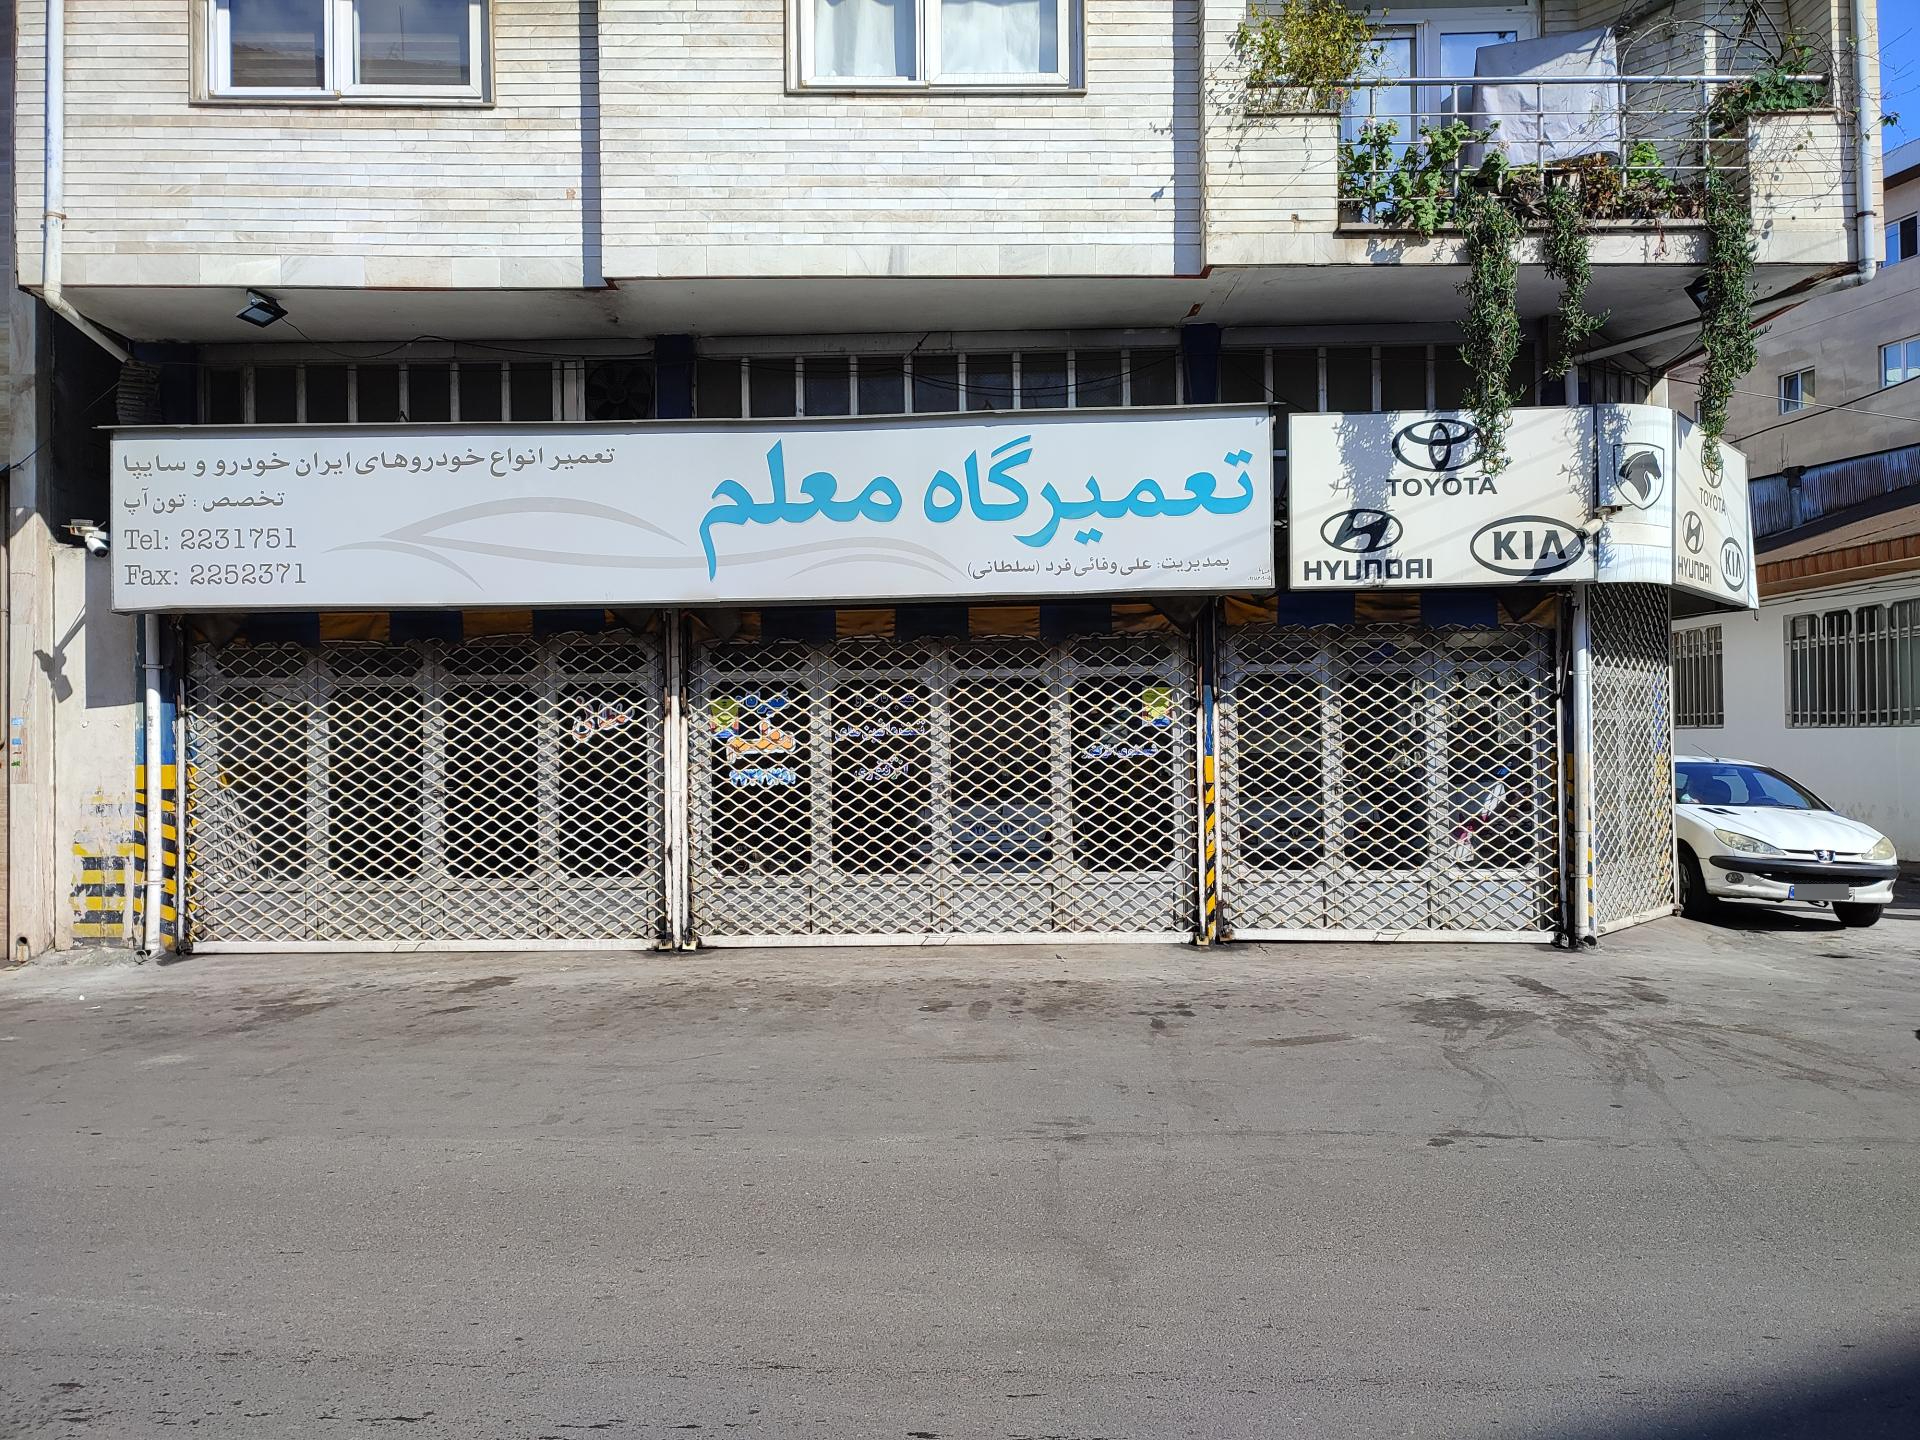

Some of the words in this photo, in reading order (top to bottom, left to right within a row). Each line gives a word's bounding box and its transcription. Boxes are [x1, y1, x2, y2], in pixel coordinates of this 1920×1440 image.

[123, 453, 186, 480] سایپا
[191, 458, 206, 477] و
[211, 452, 291, 477] خودرو
[295, 451, 351, 477] ایران
[355, 448, 485, 475] خودروهای
[490, 446, 544, 478] انواع
[547, 447, 616, 472] تعمیر
[923, 434, 1254, 548] تعمیرگاه
[1385, 476, 1498, 497] TOYOTA
[123, 487, 149, 516] آپ
[152, 493, 187, 514] تون
[698, 438, 903, 582] معلم
[1699, 486, 1727, 516] TOYOTA
[124, 529, 169, 550] Tel:
[180, 527, 297, 550] 2231751
[1492, 530, 1568, 561] KIA
[124, 564, 178, 586] Fax:
[190, 563, 307, 586] 2252371
[967, 559, 1040, 580] (سلطانی)
[1046, 558, 1072, 576] فرد
[1119, 557, 1152, 577] علی
[1303, 558, 1433, 581] HYUNDAI
[1677, 554, 1712, 585] HYUNDAI
[1724, 548, 1742, 580] KIA
